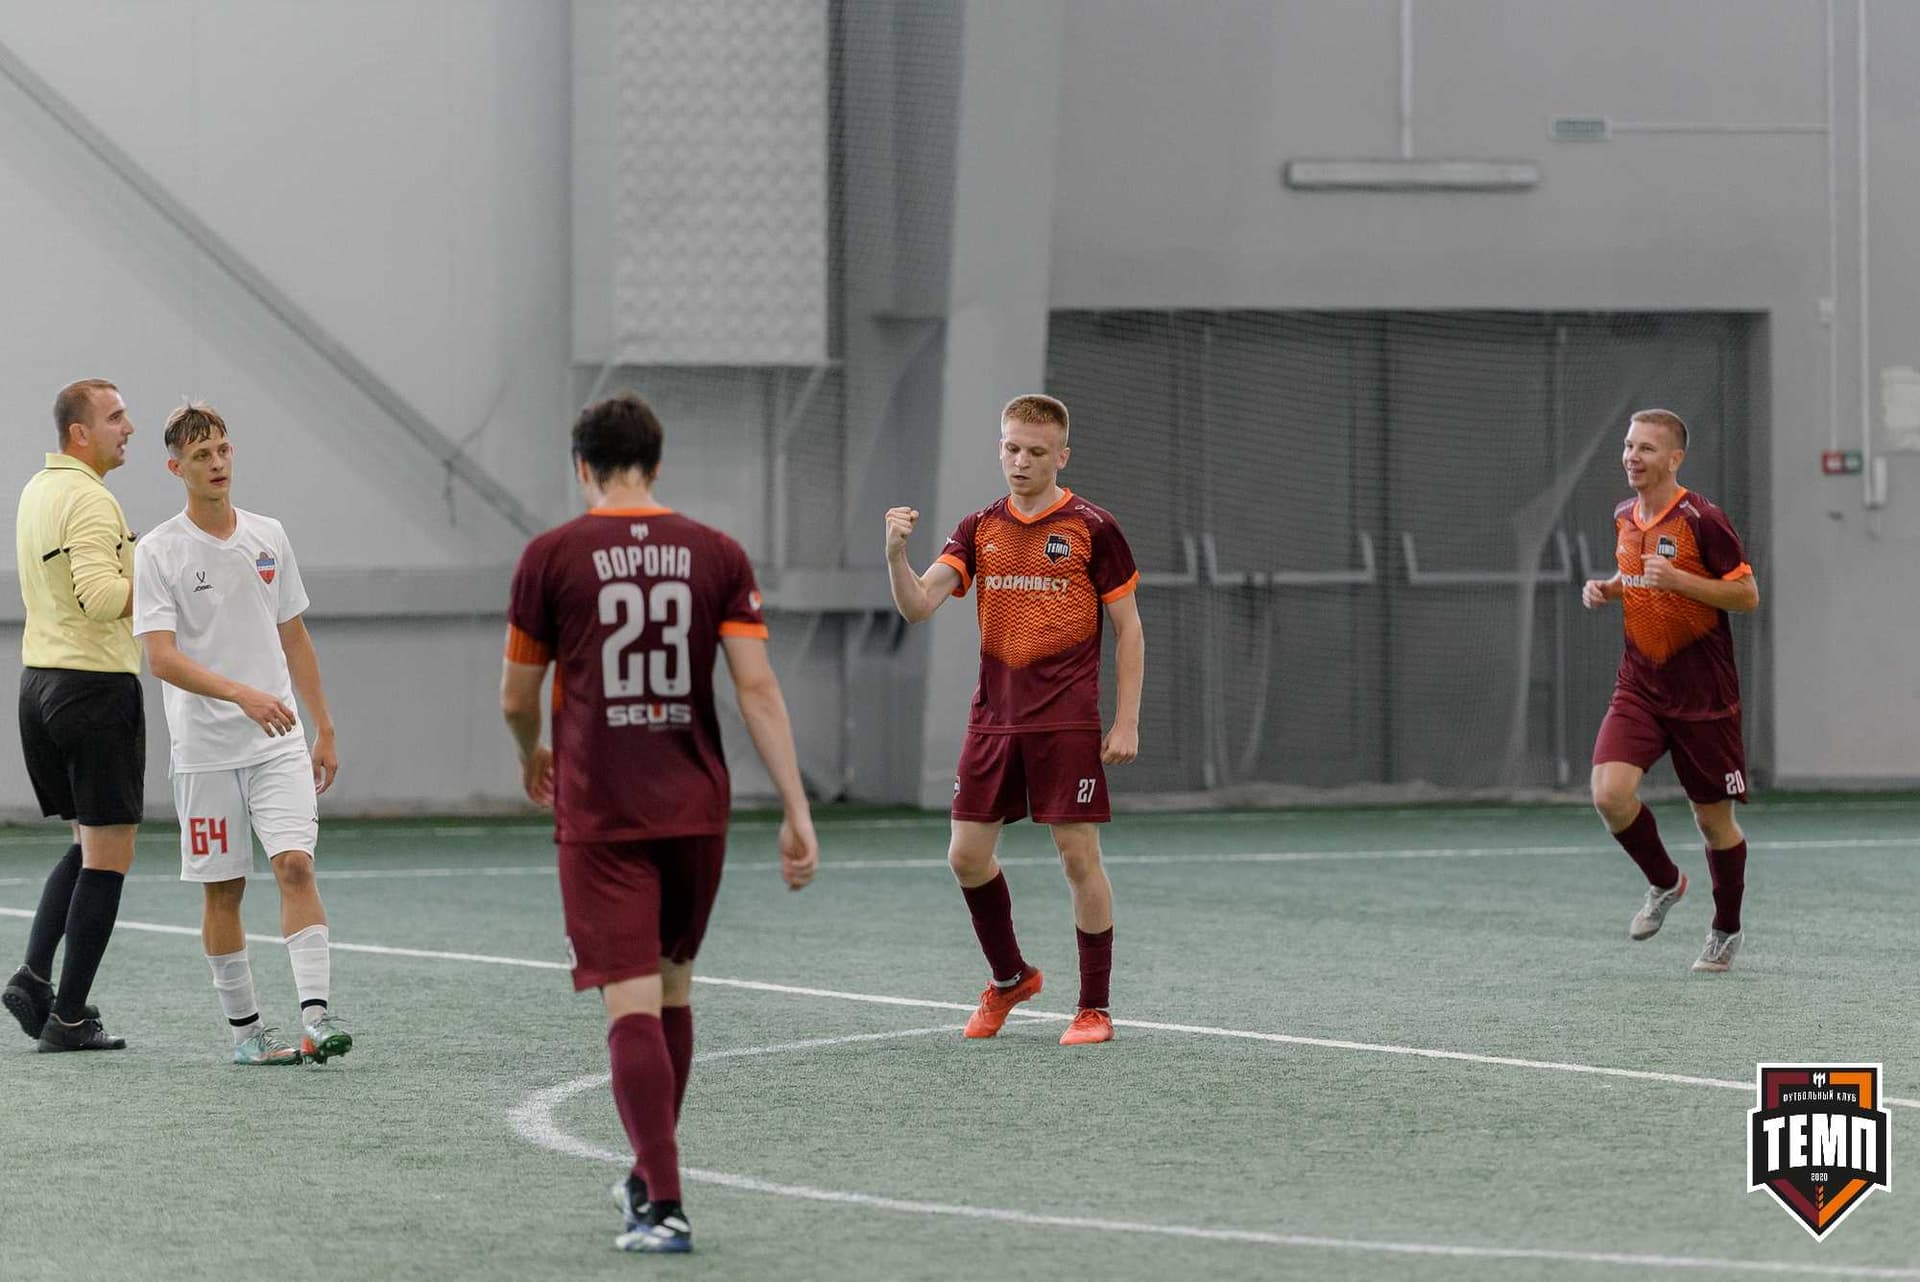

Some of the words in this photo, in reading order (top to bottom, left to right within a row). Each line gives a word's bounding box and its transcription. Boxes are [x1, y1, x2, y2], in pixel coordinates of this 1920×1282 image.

[592, 545, 691, 580] ВОРОНА
[598, 581, 692, 698] 23
[606, 703, 691, 726] SEUS
[1077, 778, 1096, 803] 27
[1725, 769, 1745, 795] 20
[190, 817, 228, 855] 64
